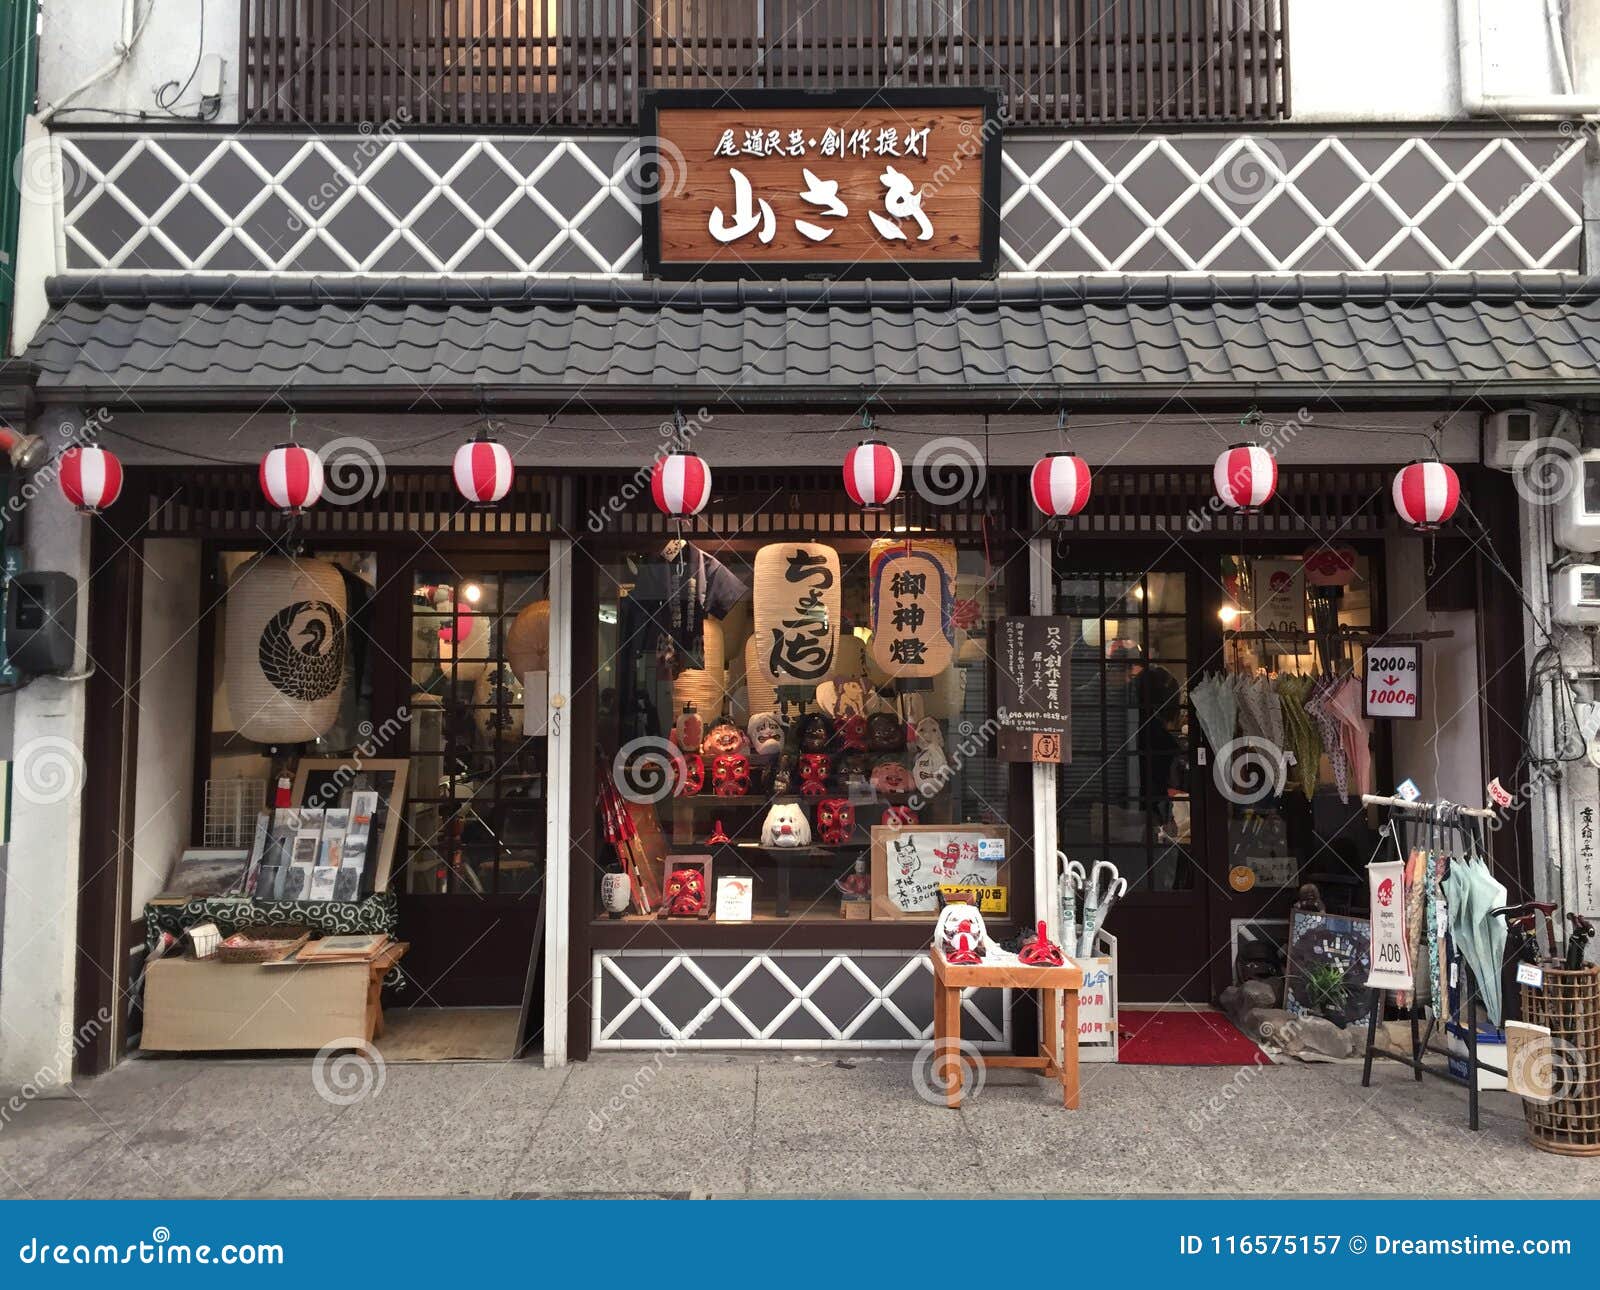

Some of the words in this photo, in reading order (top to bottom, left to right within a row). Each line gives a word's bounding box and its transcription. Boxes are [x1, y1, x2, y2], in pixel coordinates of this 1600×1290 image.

[708, 165, 935, 244] 山さき
[1370, 657, 1416, 671] 2000円
[1369, 689, 1416, 704] 1000円
[1379, 943, 1401, 963] A06
